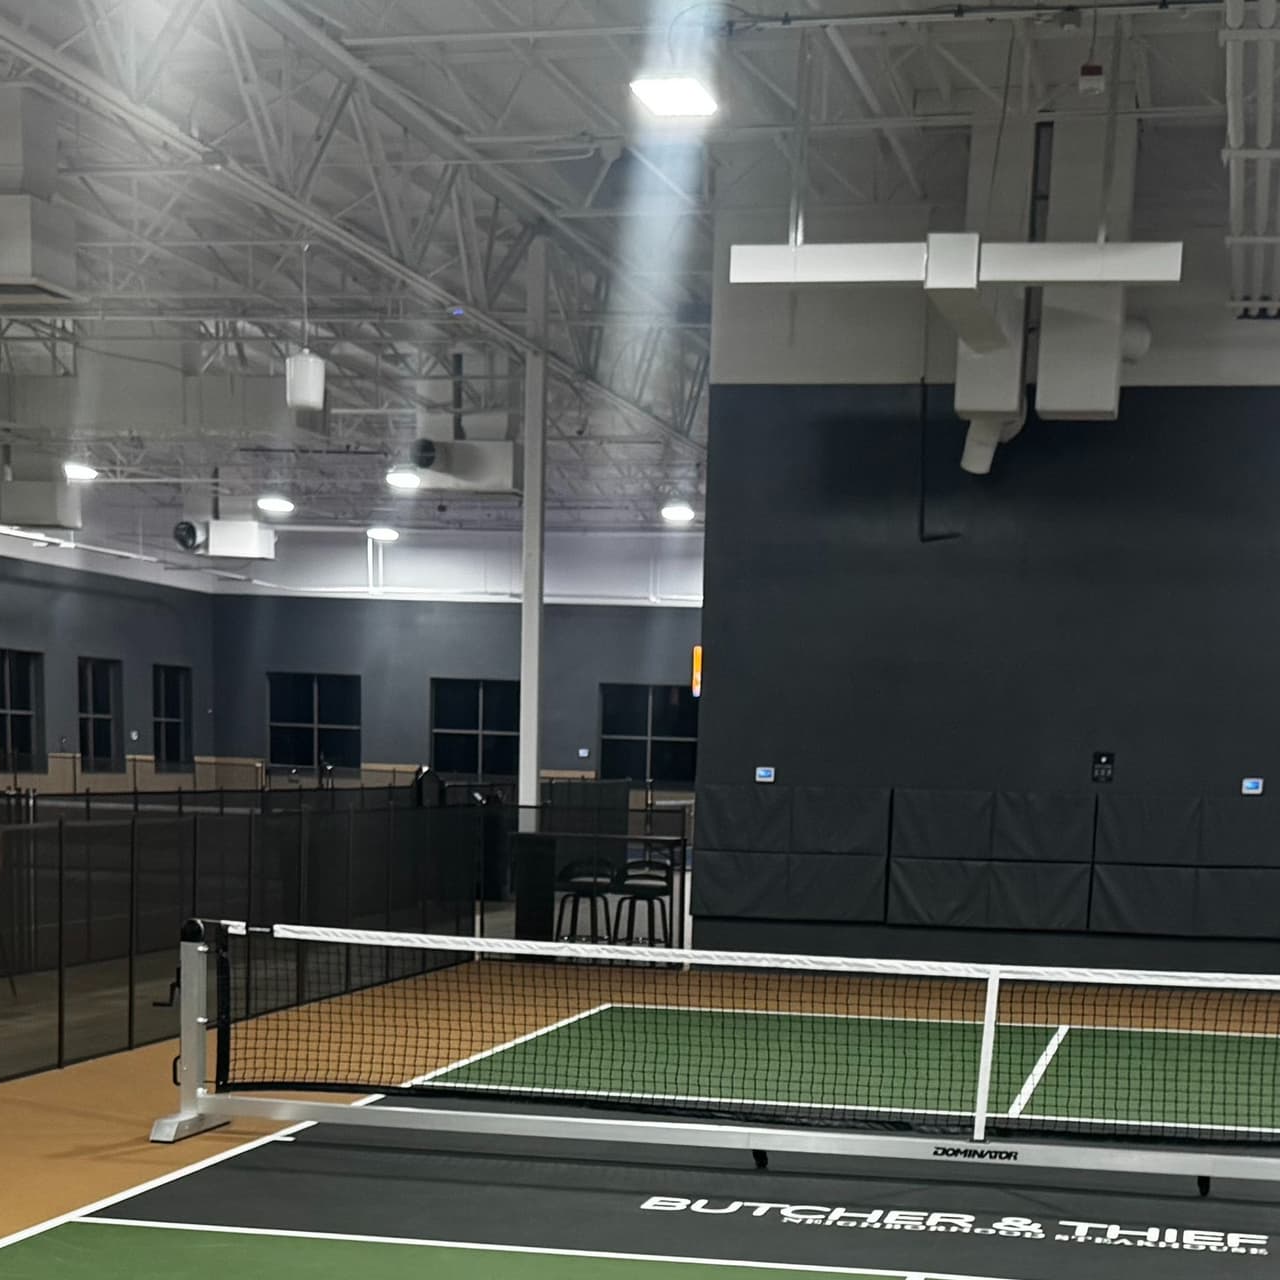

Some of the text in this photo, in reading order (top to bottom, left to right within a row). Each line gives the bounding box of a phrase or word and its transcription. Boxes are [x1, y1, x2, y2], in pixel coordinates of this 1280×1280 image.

[933, 1146, 1018, 1161] DOMINATOR
[640, 1195, 1270, 1249] BUTCHER & THIEF
[781, 1216, 1270, 1256] NEIGHBORHOOD STEAKHOUSE
